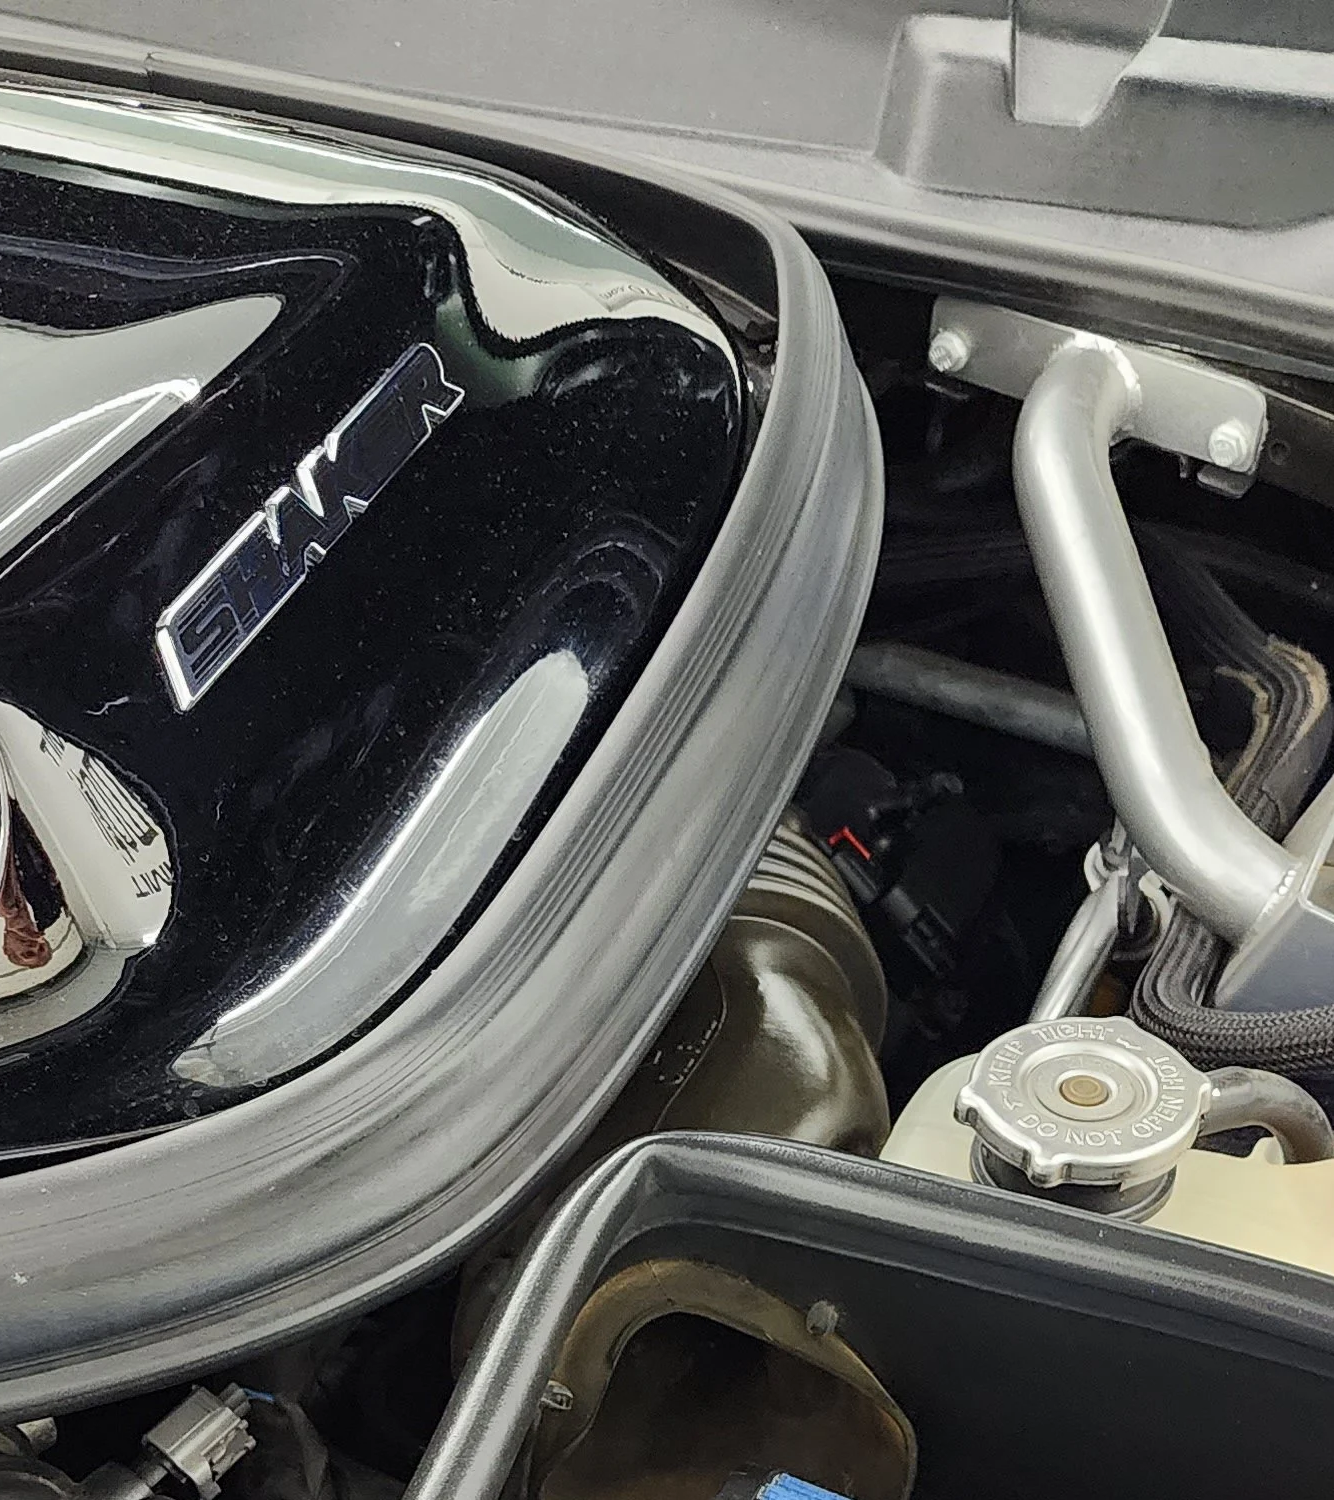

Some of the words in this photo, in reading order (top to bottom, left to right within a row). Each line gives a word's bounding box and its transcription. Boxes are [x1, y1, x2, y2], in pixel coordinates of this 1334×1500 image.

[156, 343, 464, 712] SHAKR
[988, 1040, 1024, 1086] KEEP
[1031, 1023, 1114, 1042] TIGHT
[1147, 1055, 1186, 1091] HOT
[1017, 1114, 1058, 1137] DO
[1131, 1094, 1185, 1139] OPEN
[1065, 1128, 1123, 1147] NOT
